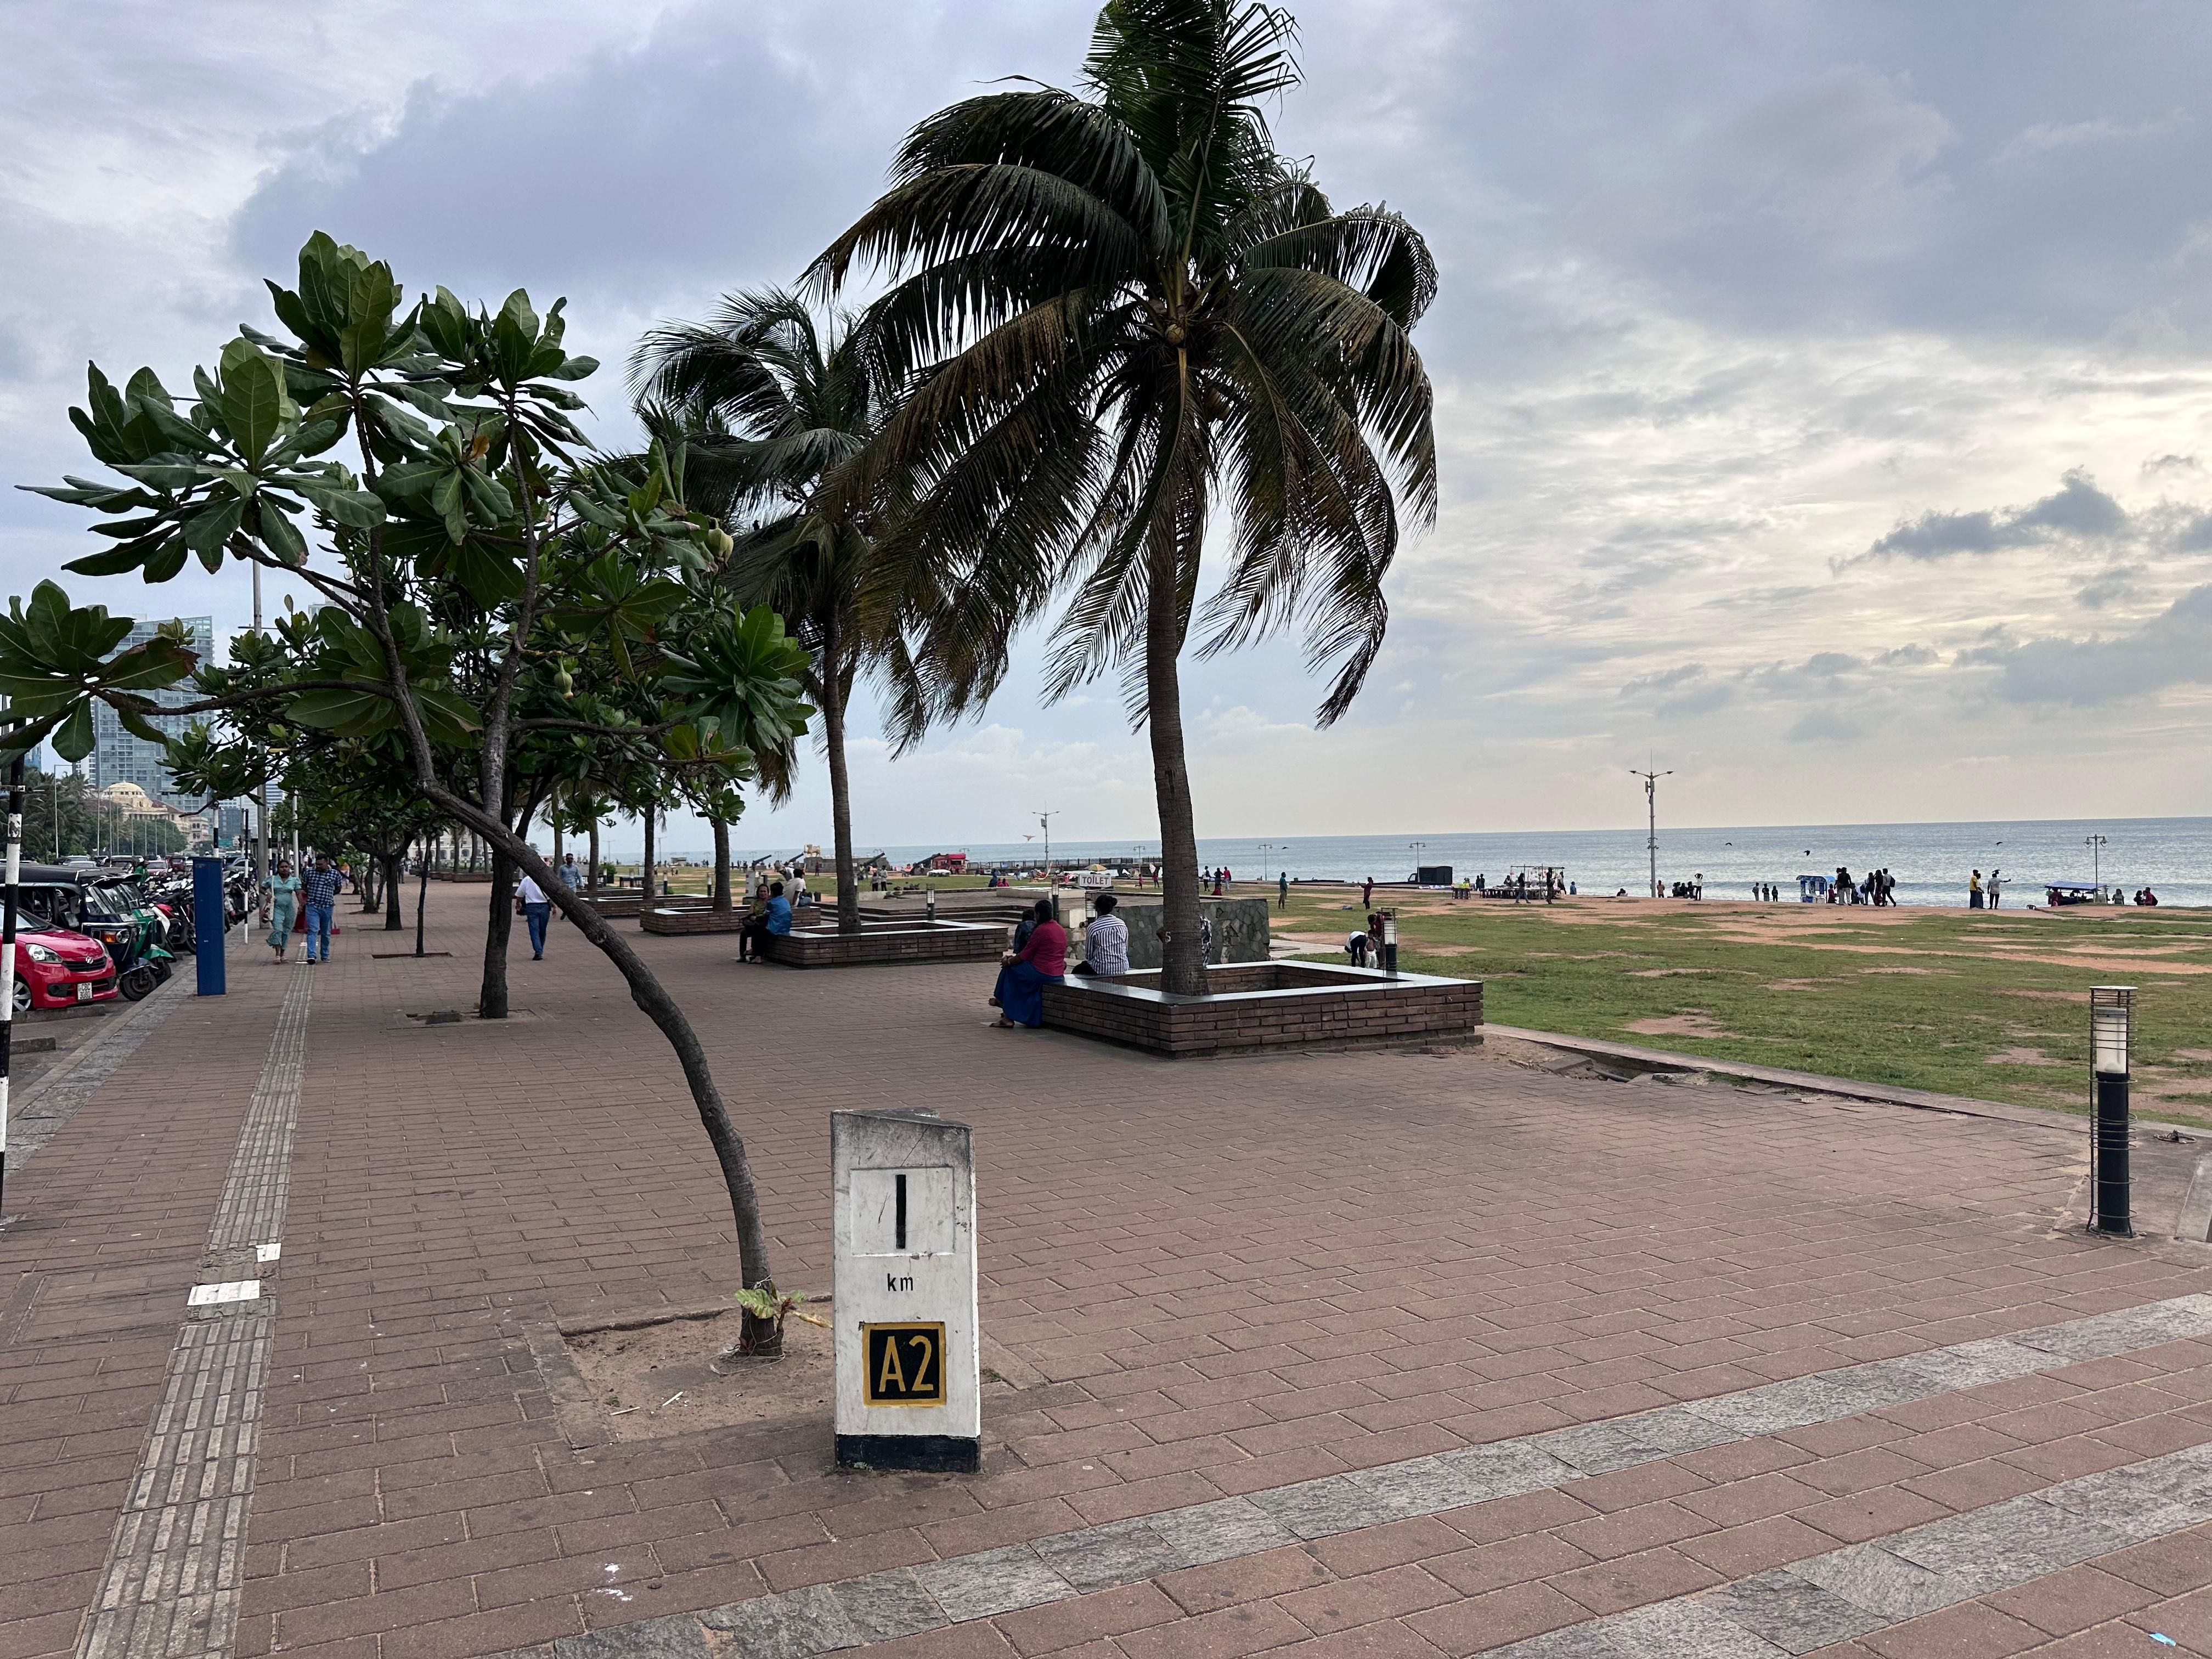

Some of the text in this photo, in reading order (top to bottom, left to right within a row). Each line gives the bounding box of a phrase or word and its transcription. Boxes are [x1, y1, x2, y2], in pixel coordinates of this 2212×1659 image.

[1082, 876, 1109, 884] TOILET
[887, 1273, 913, 1291] km
[879, 1335, 934, 1392] A2
